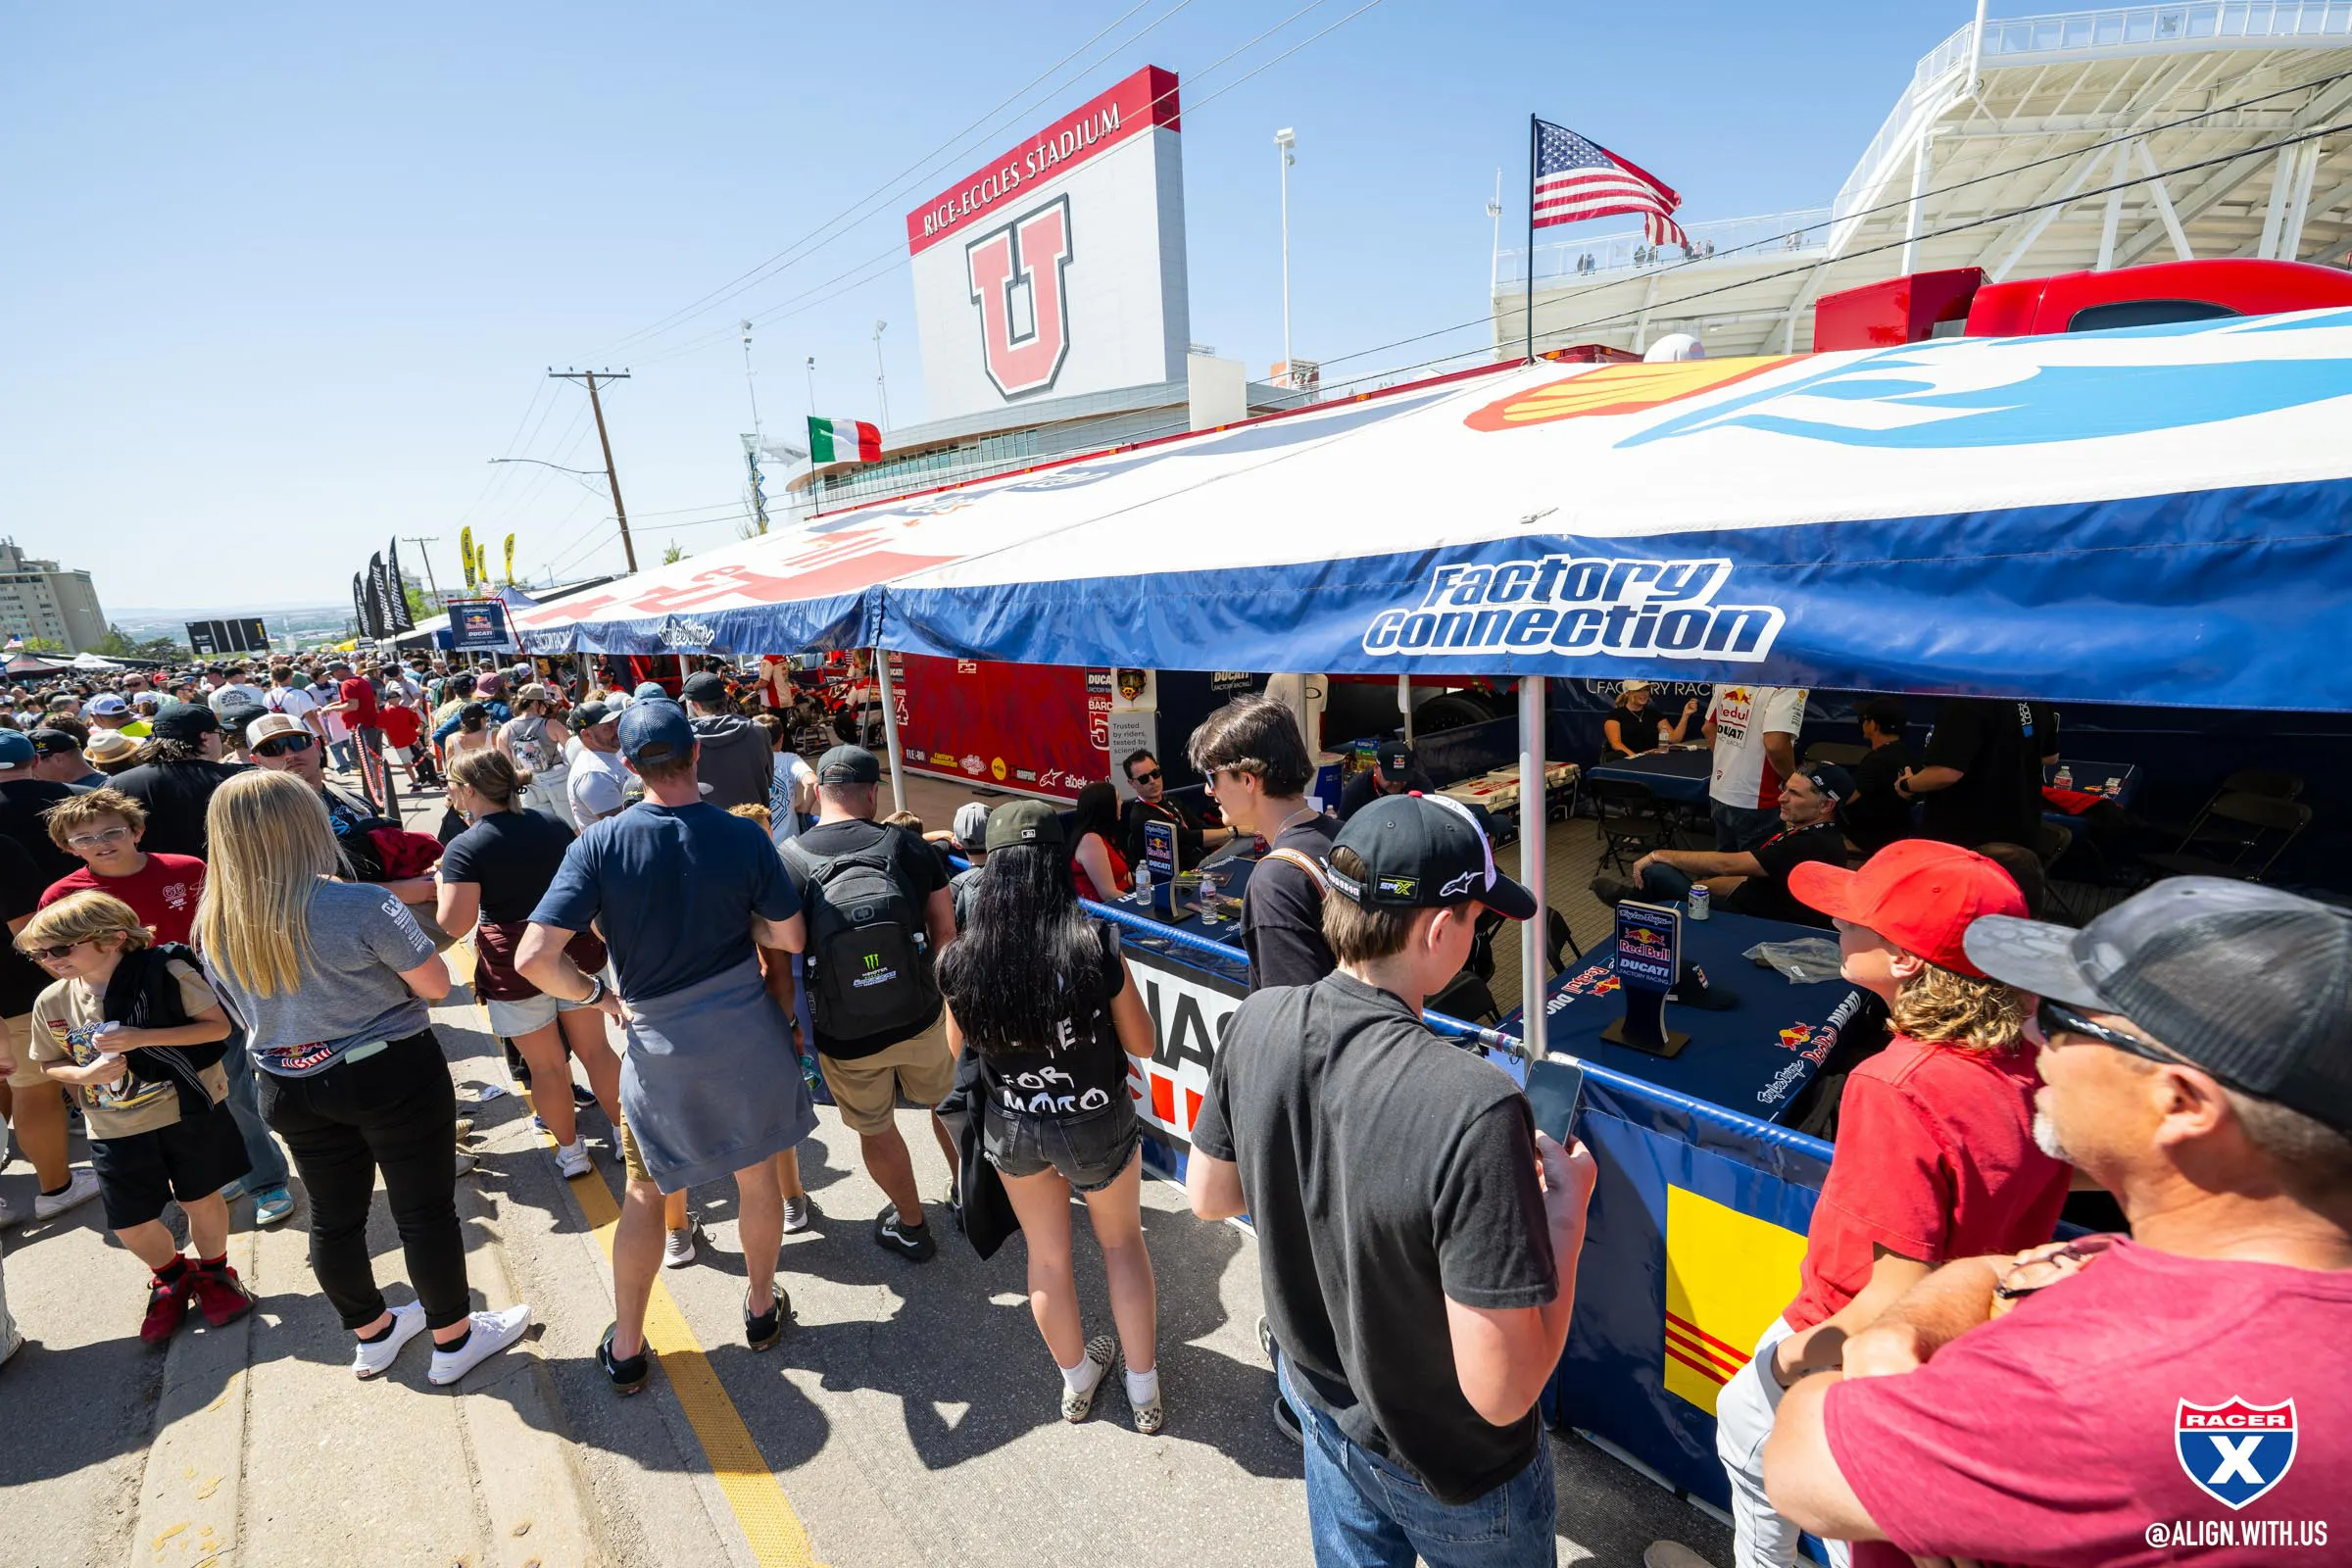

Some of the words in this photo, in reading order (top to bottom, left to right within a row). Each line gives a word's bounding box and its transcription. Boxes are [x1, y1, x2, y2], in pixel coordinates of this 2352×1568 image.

[924, 163, 1020, 237] RICE-ECCLES
[1026, 102, 1122, 178] STADIUM
[965, 192, 1074, 403] U
[1418, 554, 1733, 612] Factory
[1362, 604, 1786, 662] Connection
[1088, 674, 1111, 684] DUCA
[1214, 672, 1250, 683] DUCATI
[1596, 681, 1669, 696] FACRY
[1674, 682, 1715, 697] RACI
[1088, 701, 1113, 711] BARC
[1089, 710, 1109, 751] 5
[1149, 859, 1171, 870] DUCATI
[163, 883, 186, 898] 66
[1380, 881, 1412, 896] SMX
[1619, 939, 1645, 956] Red
[1644, 945, 1671, 962] Bull
[1620, 958, 1670, 977] DUCATI
[1619, 969, 1645, 980] FACTORY
[1646, 973, 1669, 985] RACING
[1827, 990, 1861, 1032] DUCATI
